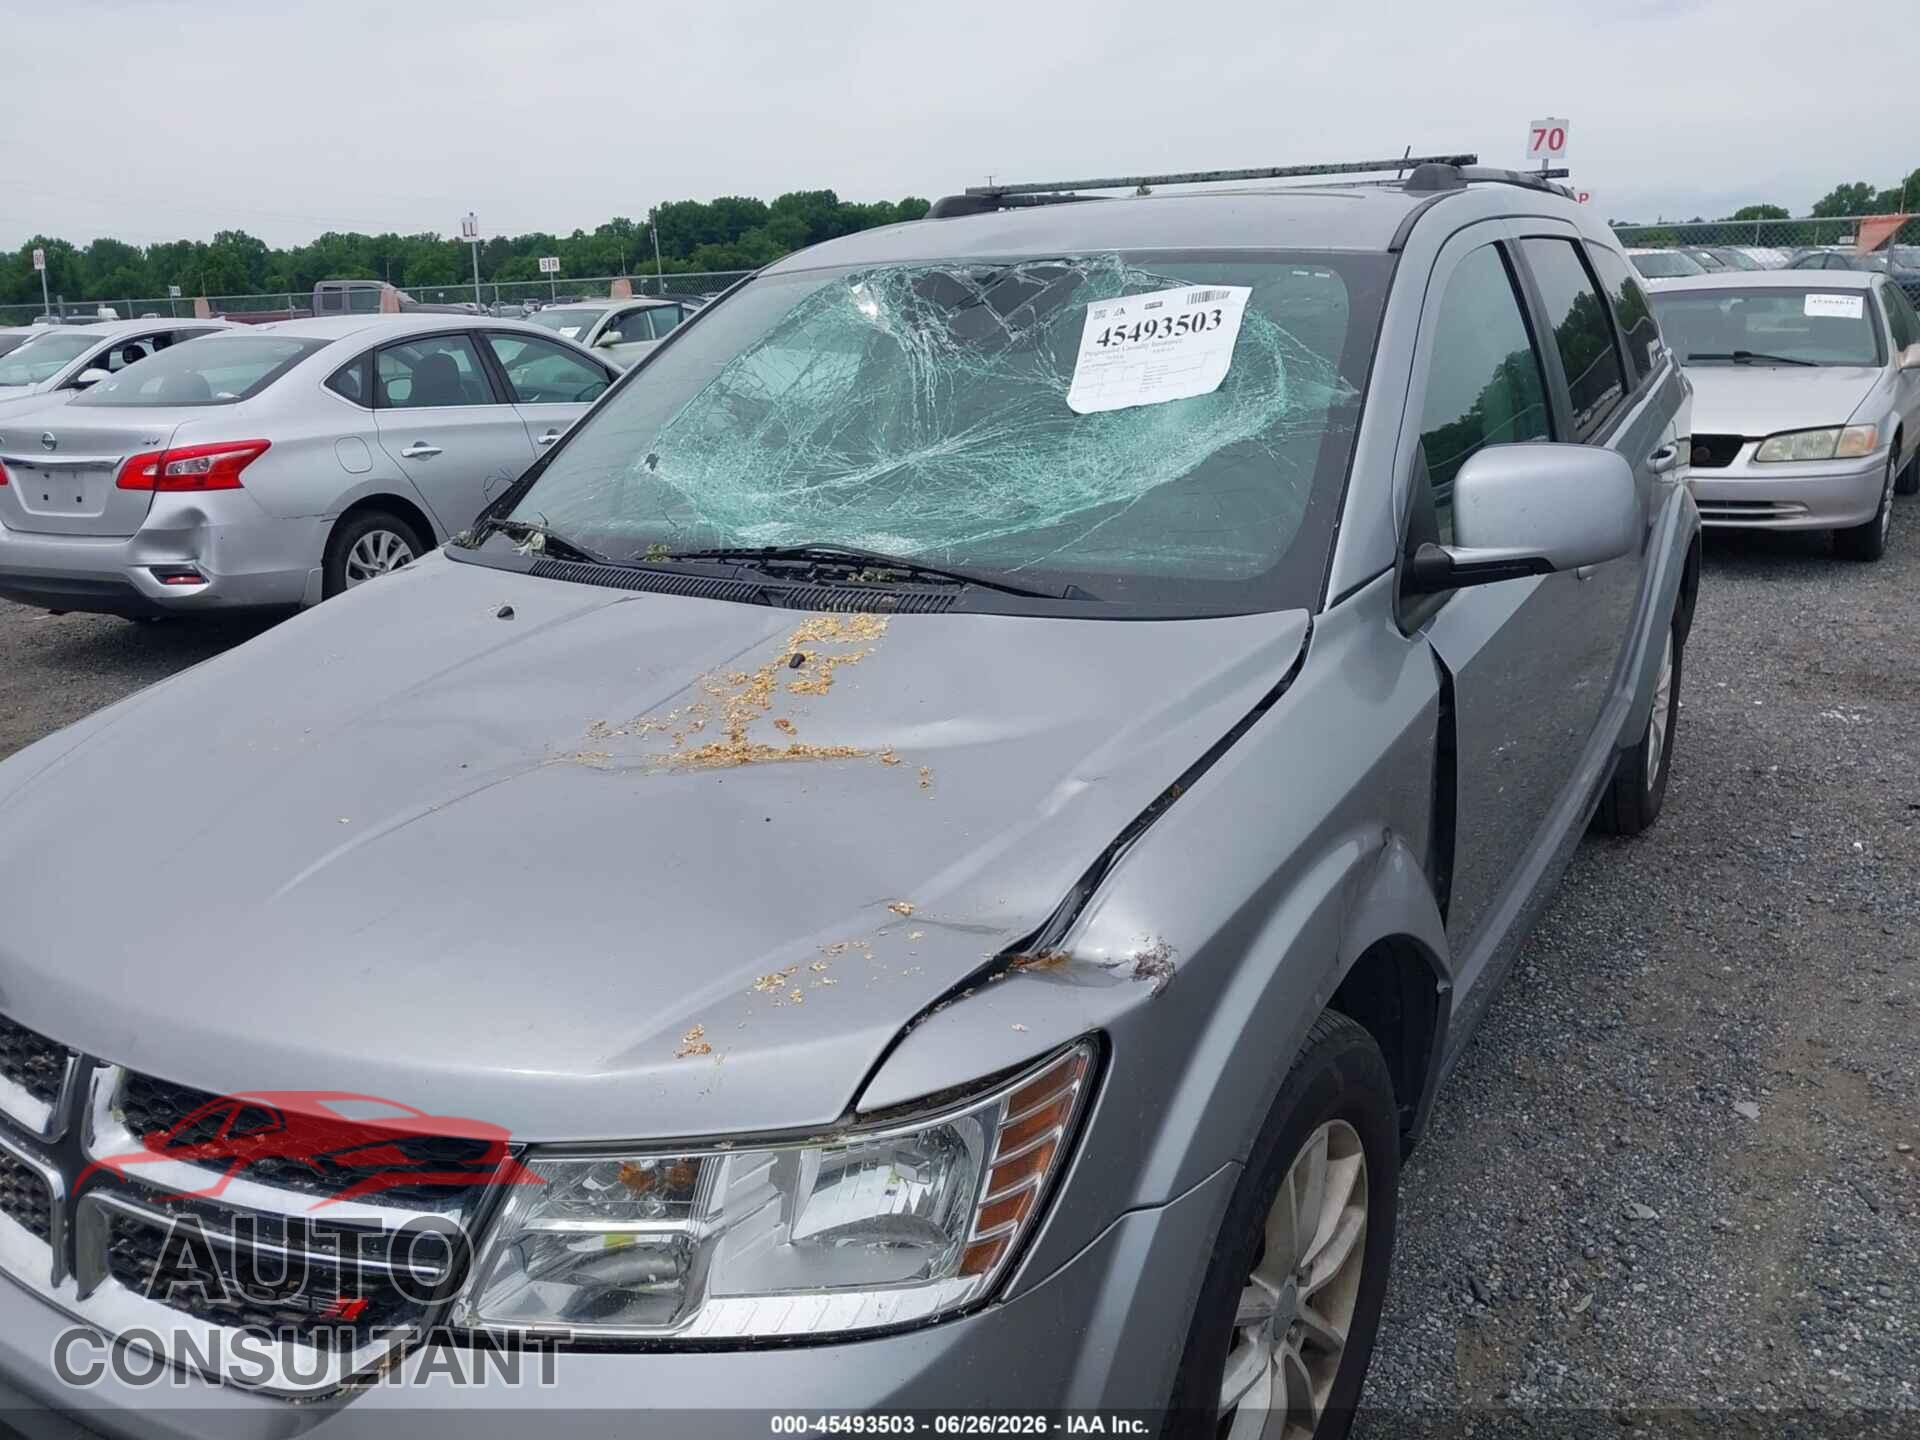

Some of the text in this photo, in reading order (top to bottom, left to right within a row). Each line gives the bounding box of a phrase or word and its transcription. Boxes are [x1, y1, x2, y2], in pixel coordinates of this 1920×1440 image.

[1533, 127, 1565, 151] 70
[462, 222, 477, 237] LL
[1096, 308, 1222, 347] 45493503
